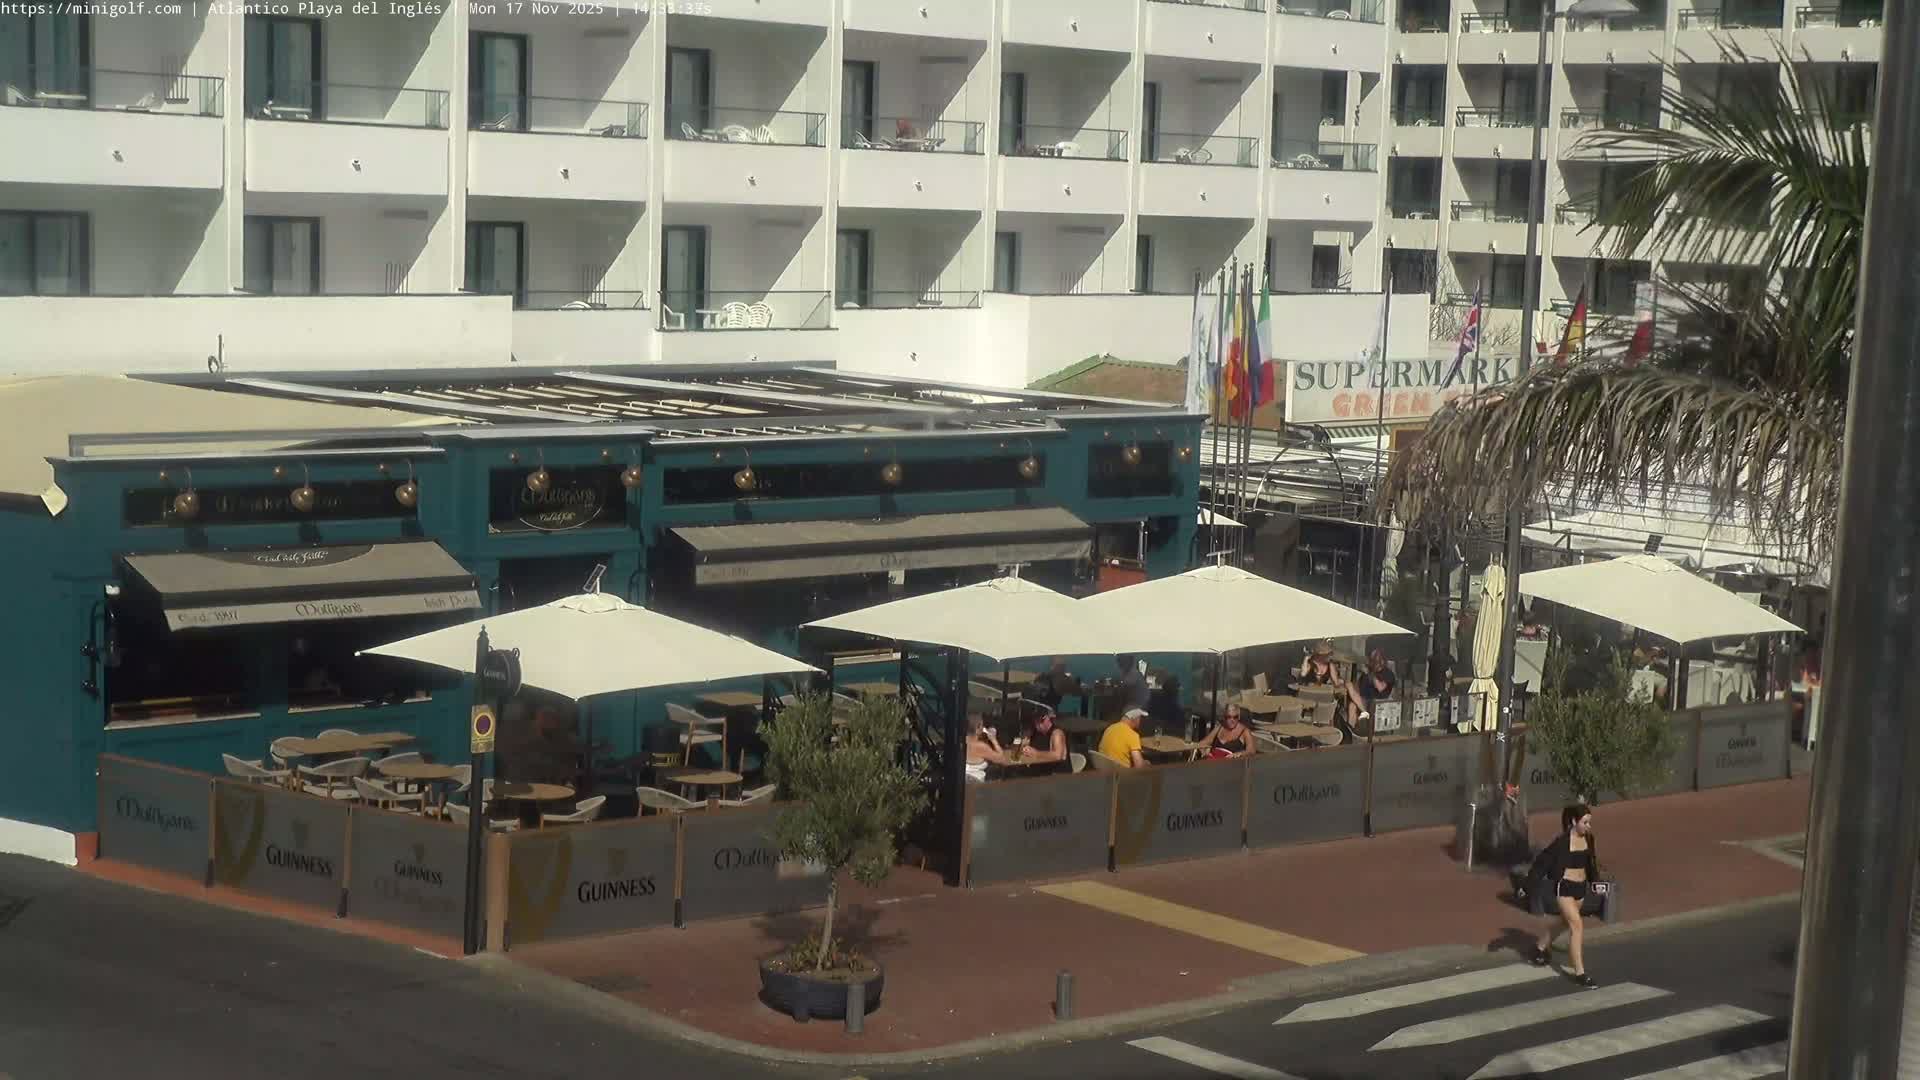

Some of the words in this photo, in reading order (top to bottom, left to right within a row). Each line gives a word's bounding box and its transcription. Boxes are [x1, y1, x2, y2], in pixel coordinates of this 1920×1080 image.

[1295, 357, 1517, 390] SUPERMARK
[1166, 808, 1224, 832] GUINNESS
[266, 844, 334, 878] GUINNESS
[578, 877, 656, 904] GUINNESS
